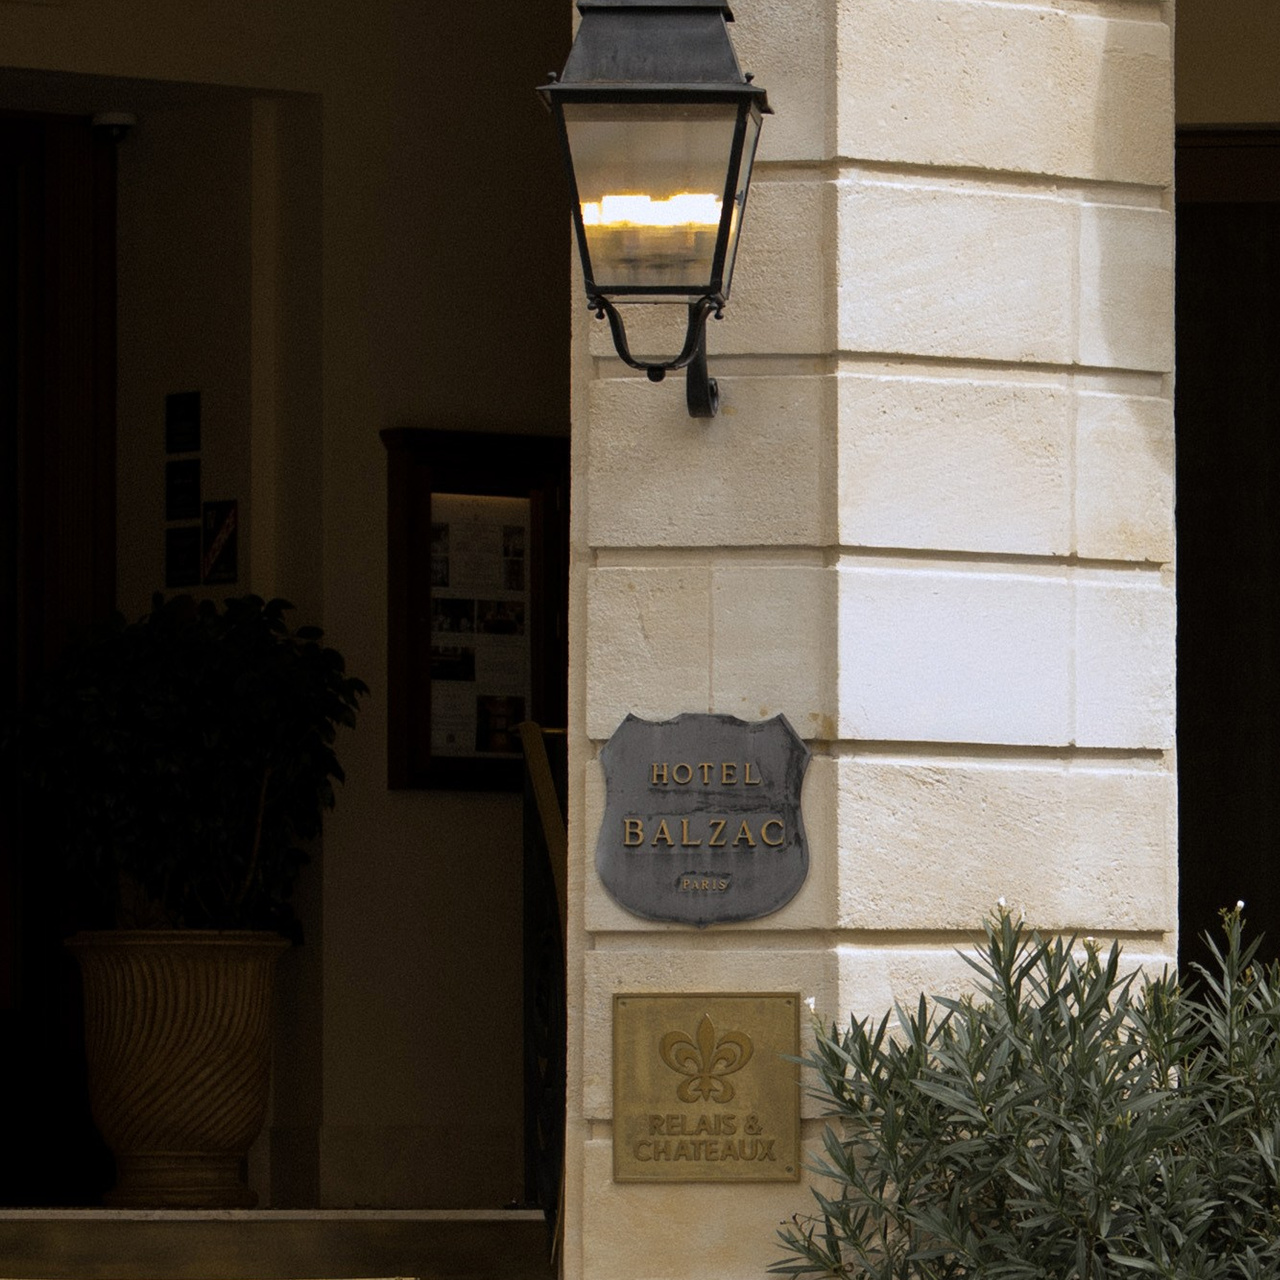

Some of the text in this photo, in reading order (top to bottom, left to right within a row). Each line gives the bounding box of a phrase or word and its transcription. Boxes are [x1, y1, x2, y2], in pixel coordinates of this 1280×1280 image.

[651, 762, 762, 785] HOTEL
[622, 818, 785, 847] BALZAC
[682, 878, 729, 890] PARIS
[648, 1113, 762, 1136] RELAIS &
[633, 1139, 777, 1162] CHATEAUX
